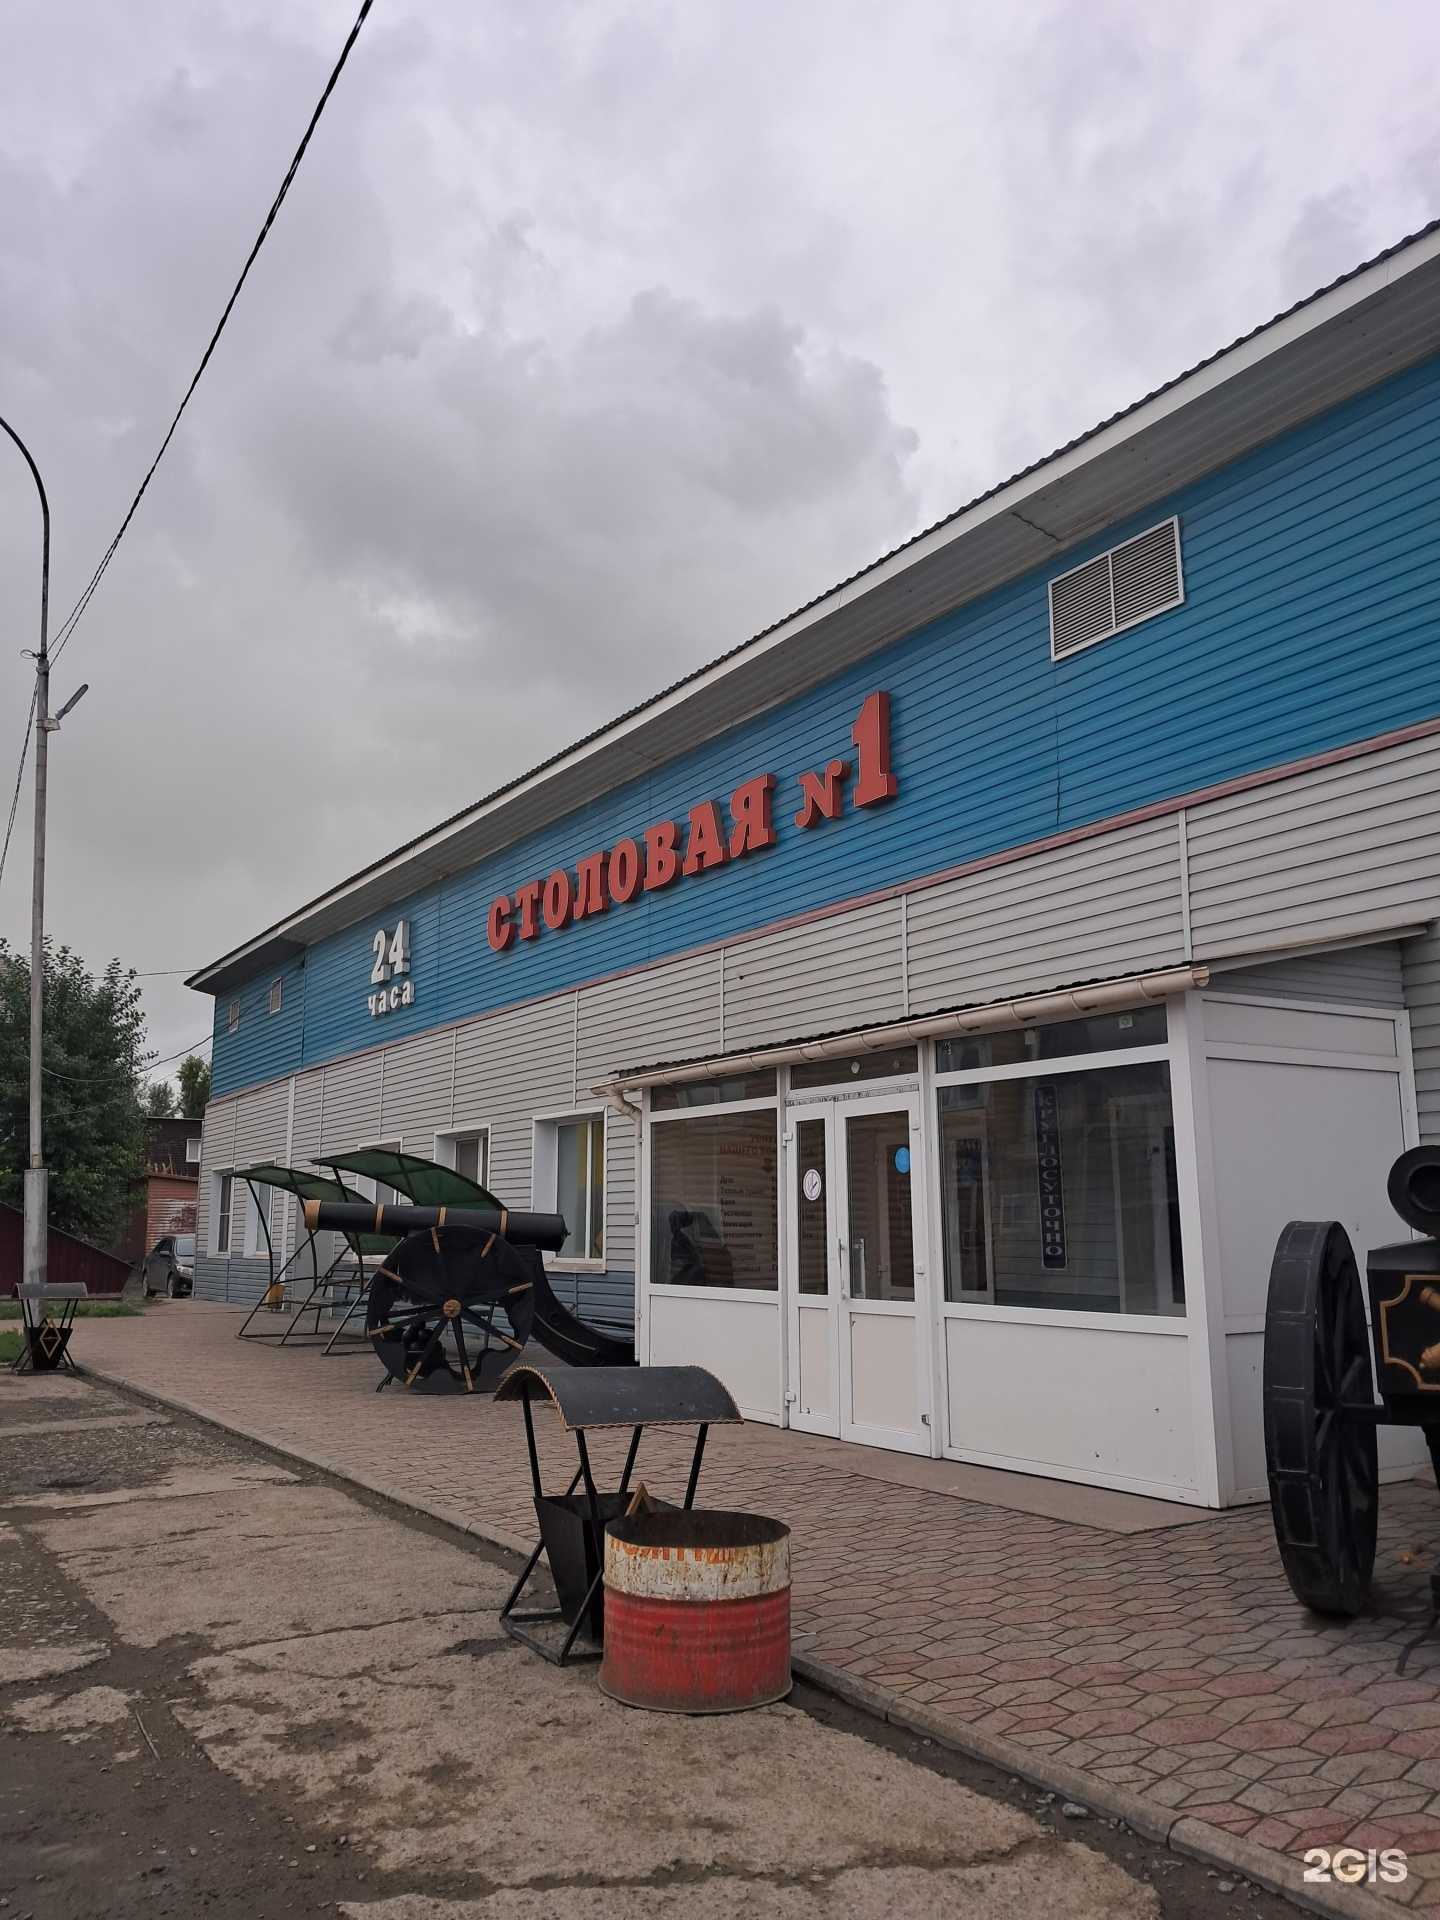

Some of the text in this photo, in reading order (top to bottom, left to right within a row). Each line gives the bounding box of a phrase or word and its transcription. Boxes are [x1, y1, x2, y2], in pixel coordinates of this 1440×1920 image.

[487, 772, 777, 953] СТОЛОВАЯ
[371, 919, 411, 985] 24
[367, 980, 416, 1017] часа
